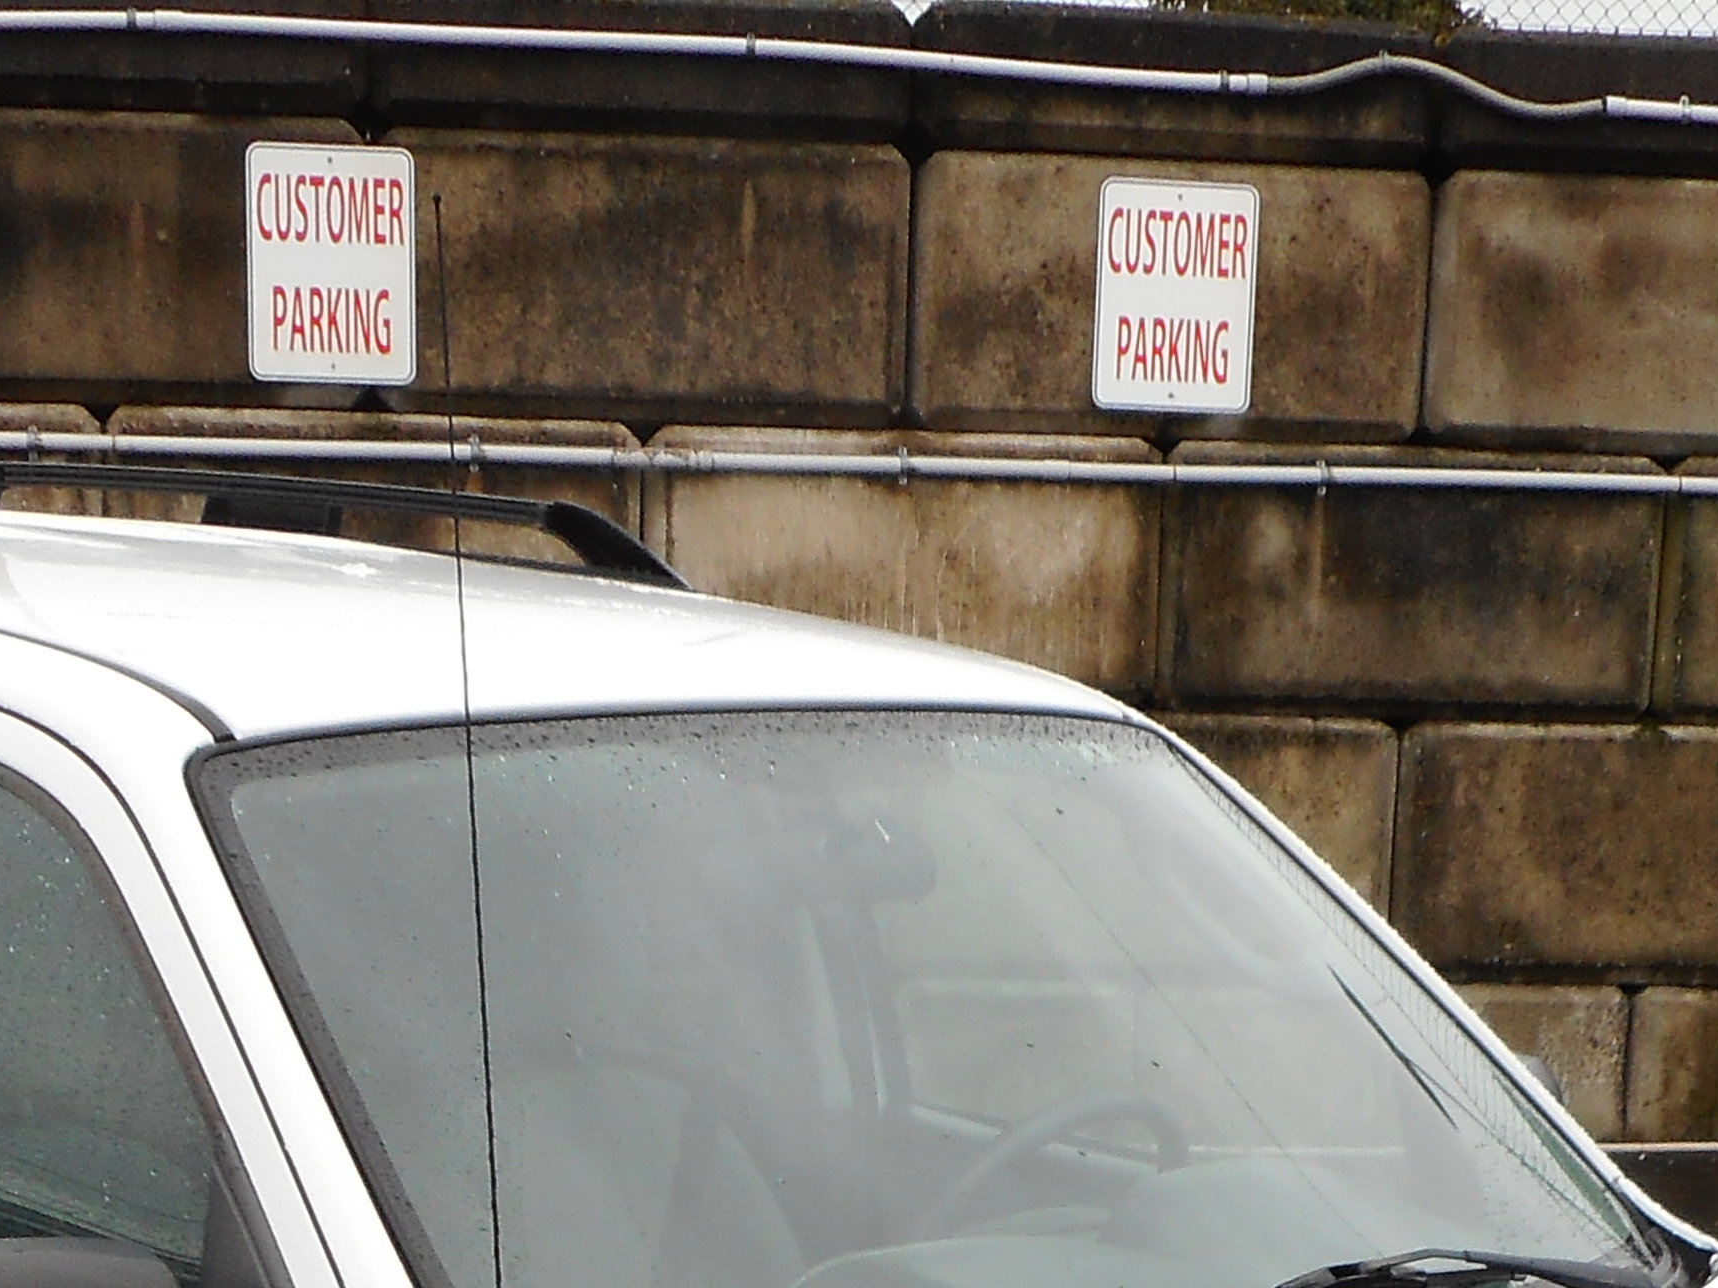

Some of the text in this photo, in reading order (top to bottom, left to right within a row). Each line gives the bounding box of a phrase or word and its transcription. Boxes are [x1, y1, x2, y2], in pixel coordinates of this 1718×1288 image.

[257, 173, 407, 249] CUSTOMER
[1108, 207, 1250, 281] CUSTOMER
[271, 284, 395, 358] PARKING
[1115, 315, 1231, 387] PARKING
